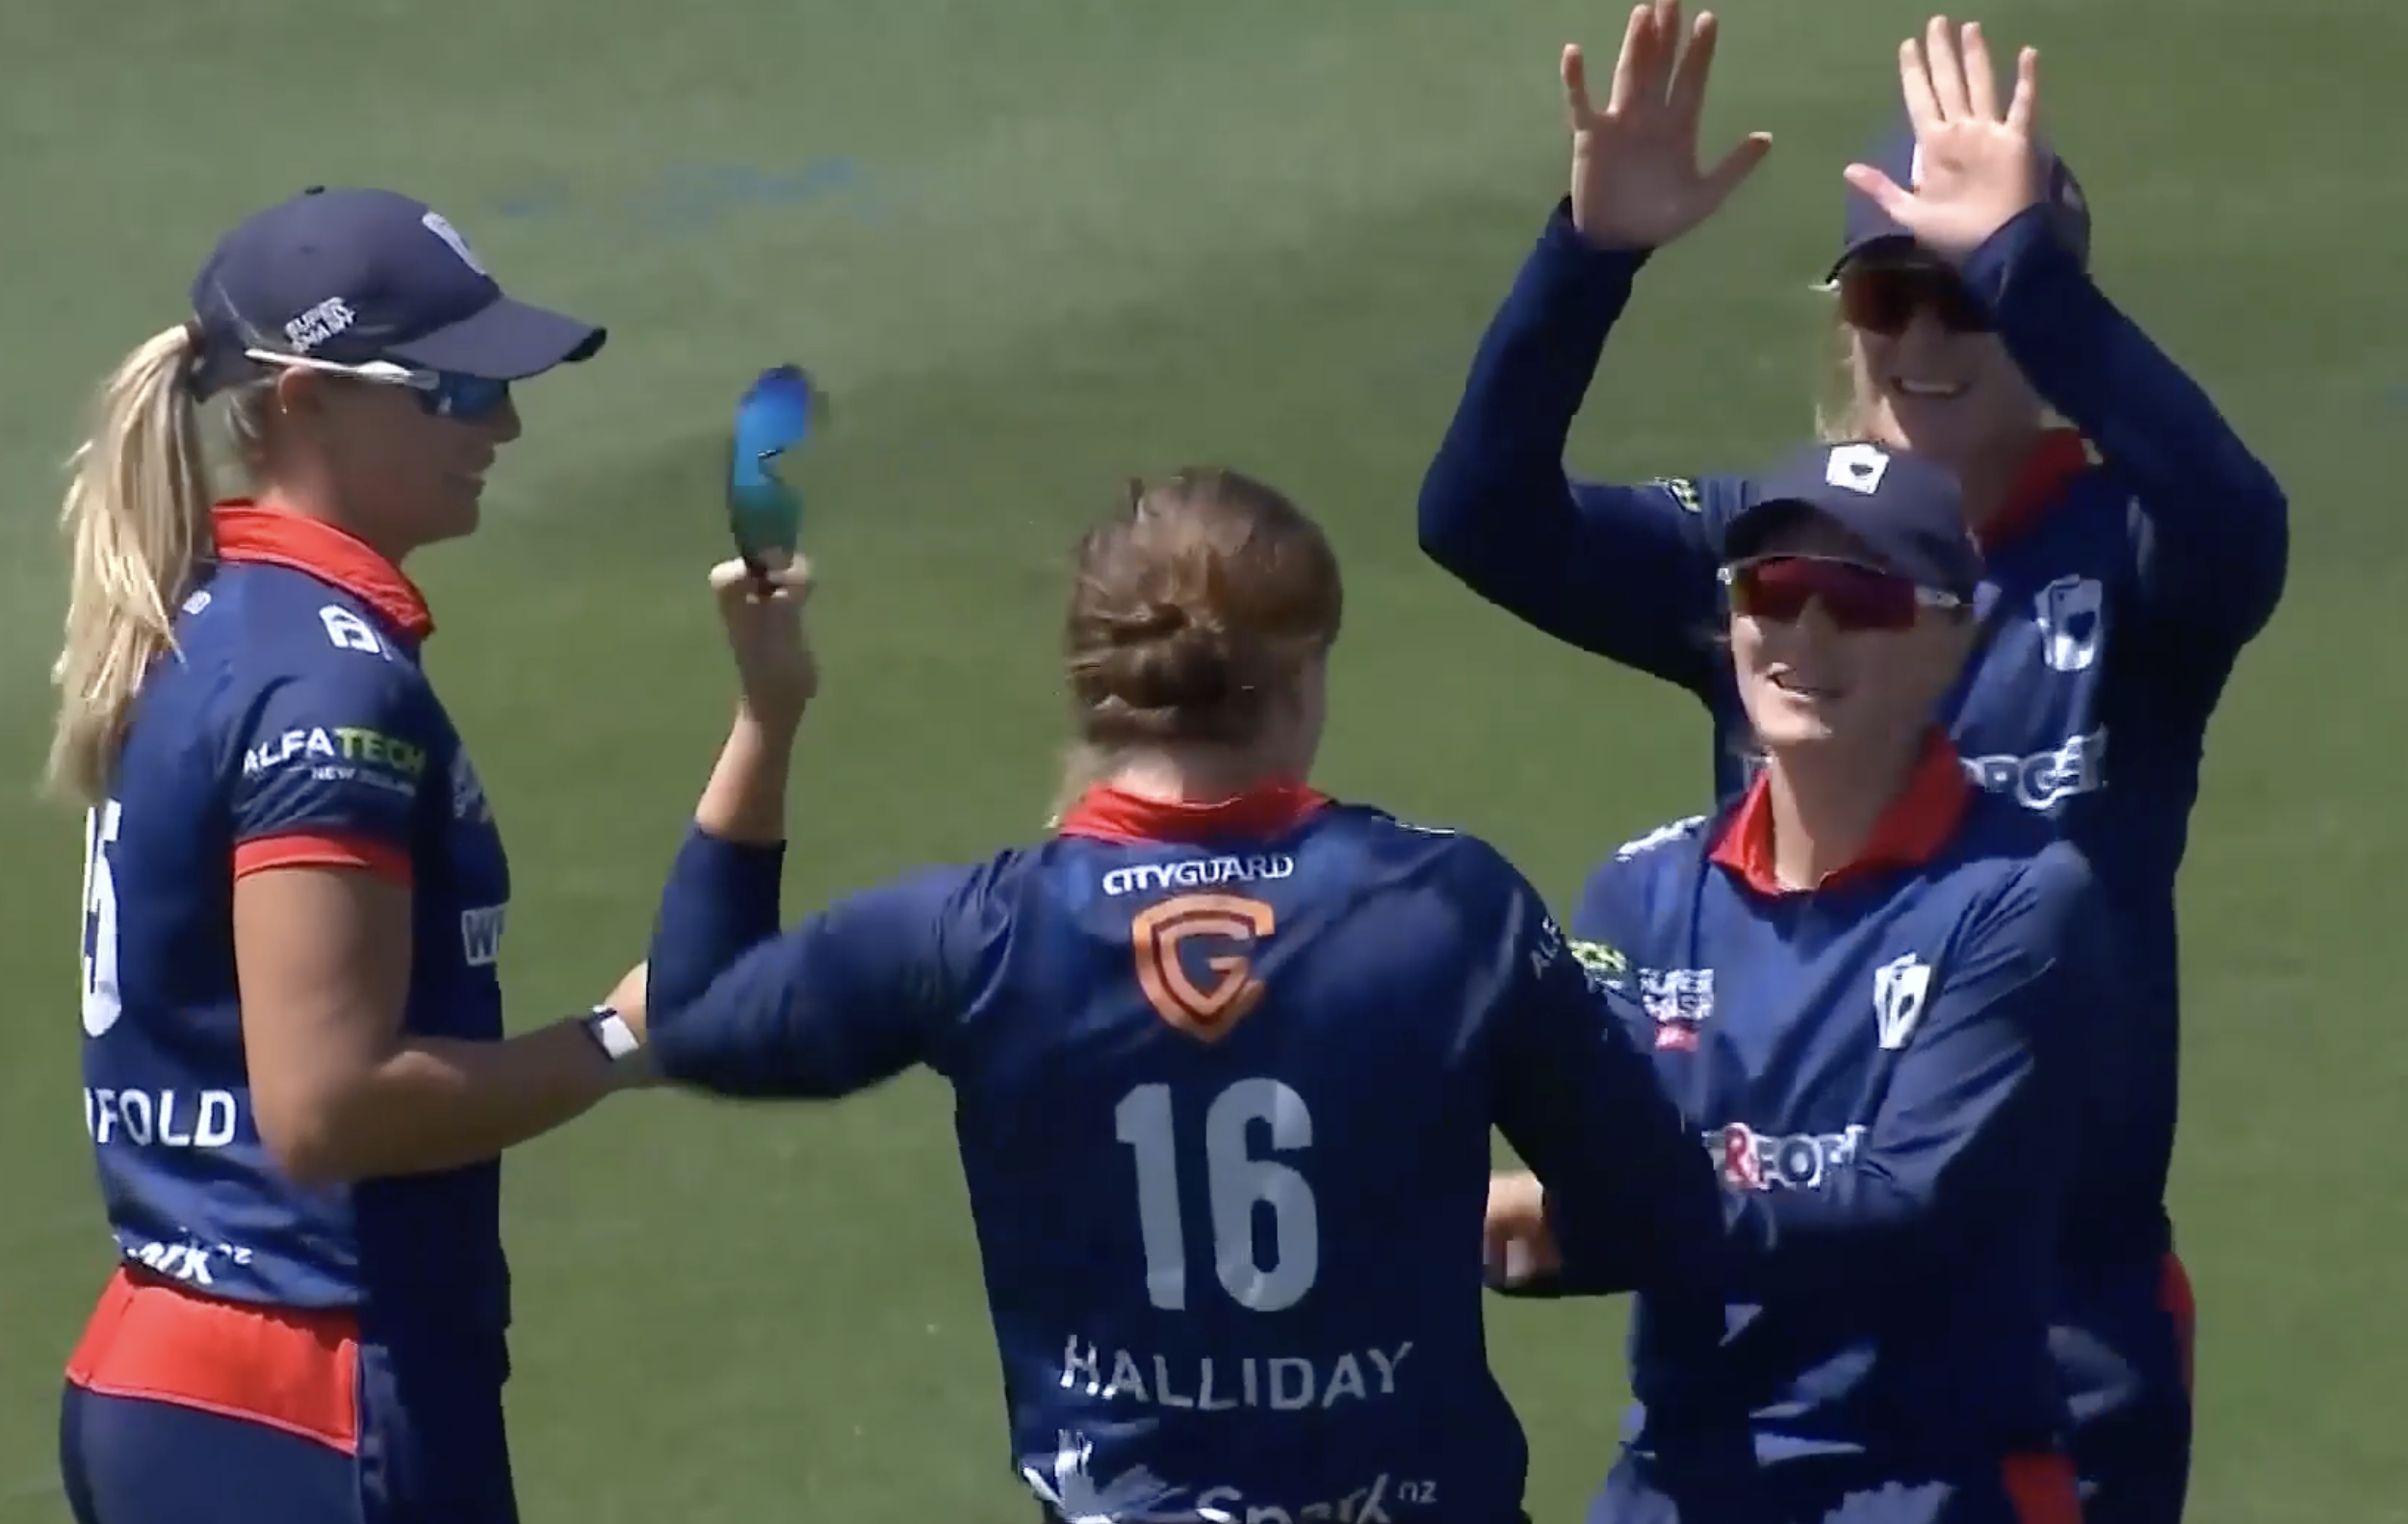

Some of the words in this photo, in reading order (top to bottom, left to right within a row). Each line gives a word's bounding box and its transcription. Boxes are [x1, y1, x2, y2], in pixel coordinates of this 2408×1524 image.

[244, 727, 427, 775] ALFATECH
[1102, 856, 1294, 895] CITYGUARD
[1115, 1077, 1319, 1312] 16
[1060, 1334, 1413, 1410] HALLIDAY
